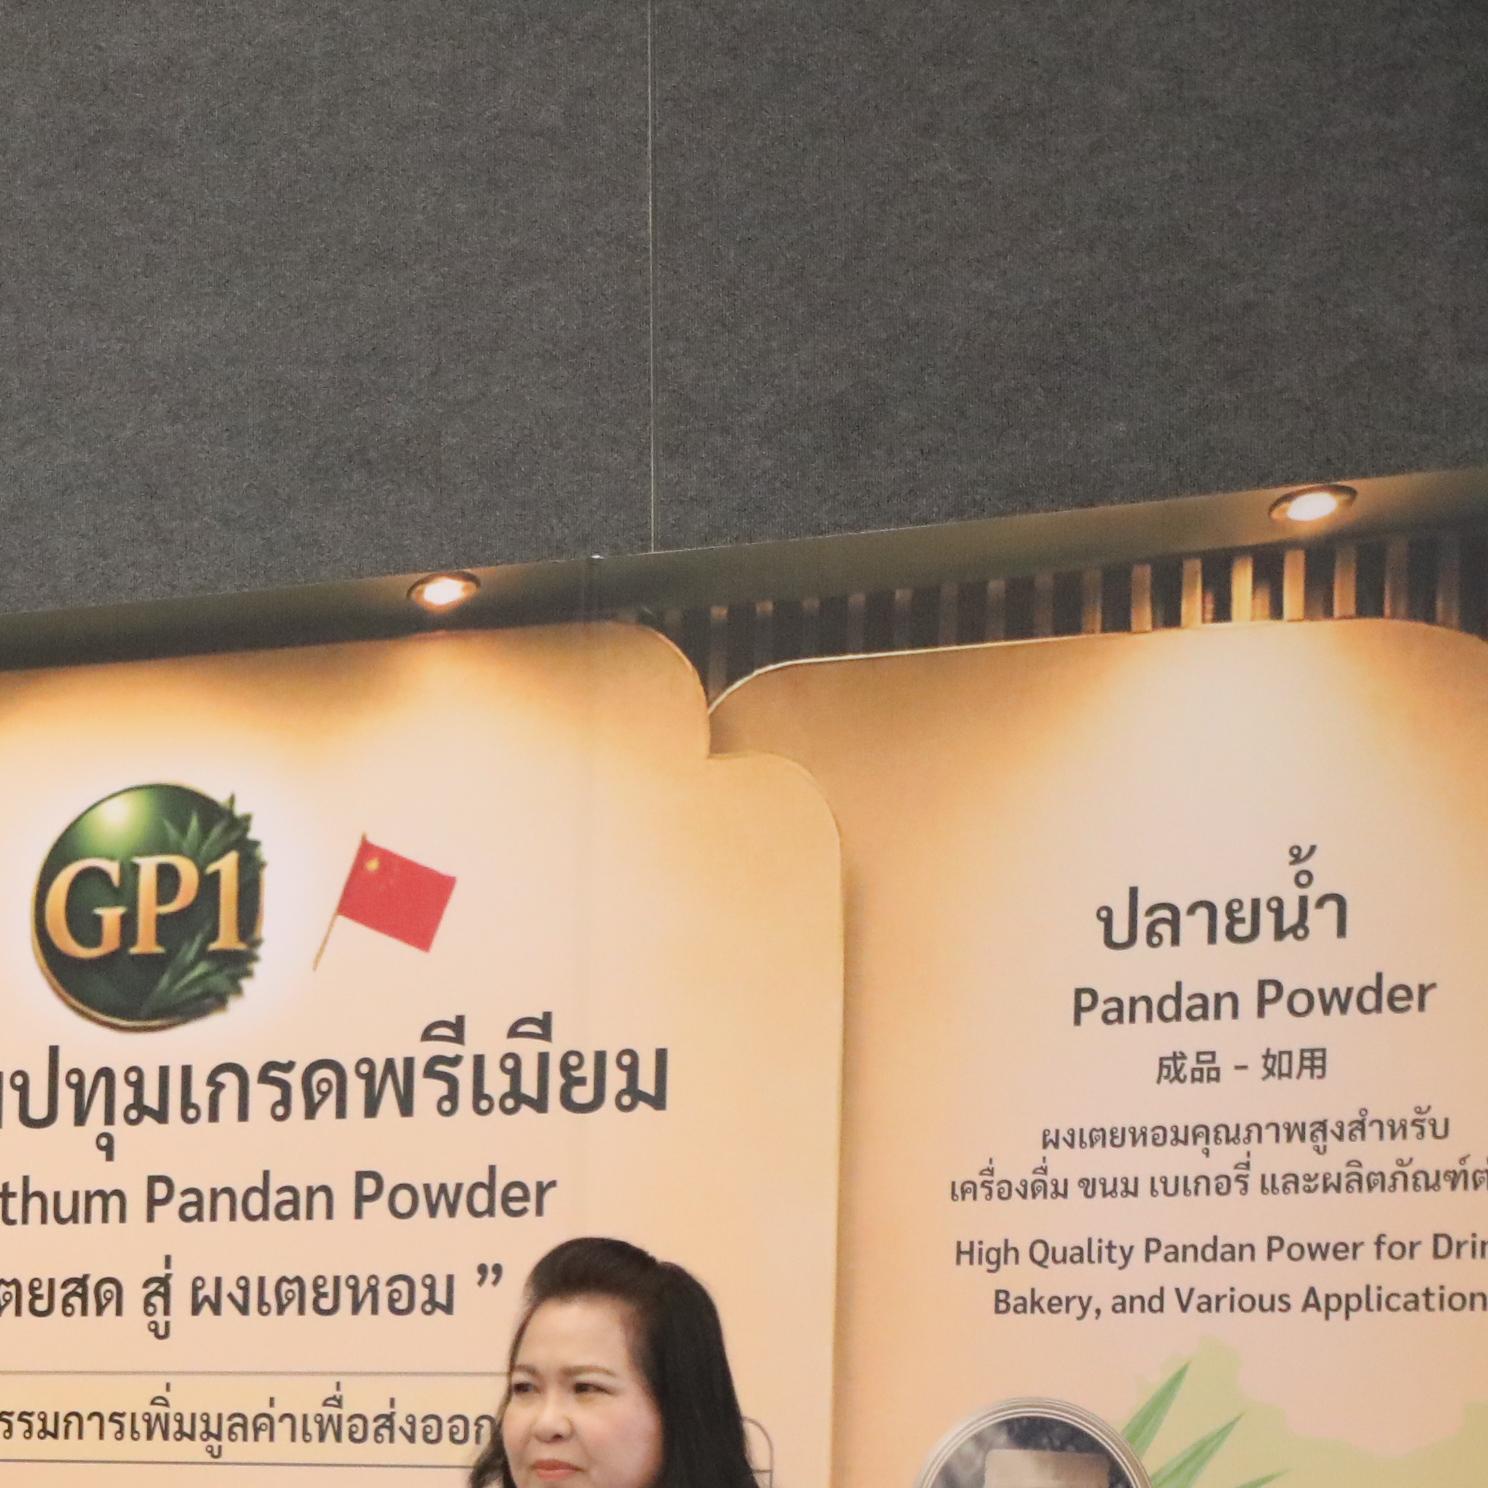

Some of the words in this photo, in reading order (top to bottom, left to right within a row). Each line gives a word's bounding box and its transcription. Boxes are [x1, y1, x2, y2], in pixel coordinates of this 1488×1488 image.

[42, 848, 266, 962] GP1
[1095, 844, 1348, 951] ปลายน้ำ
[1073, 980, 1240, 1027] Pandan
[1256, 971, 1437, 1019] Powder
[1156, 1050, 1221, 1085] 成品
[1261, 1047, 1327, 1082] 如用
[1041, 1104, 1450, 1159] ผงเตยหอมคุณภาพสูงสำหรับ
[146, 1169, 334, 1224] Pandan
[354, 1164, 558, 1220] Powder
[950, 1155, 1069, 1202] เครื่องดื่ม
[1077, 1176, 1139, 1199] ขนม
[1150, 1150, 1251, 1198] เบเกอรี่
[1260, 1153, 1488, 1194] และผลิตภัณฑ์ต
[955, 1238, 1020, 1274] High
[1028, 1237, 1135, 1271] Quality
[1144, 1234, 1256, 1264] Pandan
[1266, 1235, 1365, 1262] Power
[1373, 1233, 1422, 1261] for
[141, 1254, 173, 1341] สู่
[190, 1273, 455, 1317] ผงเตยหอม
[994, 1287, 1102, 1321] Bakery,
[1111, 1286, 1165, 1315] and
[1174, 1286, 1292, 1314] Various
